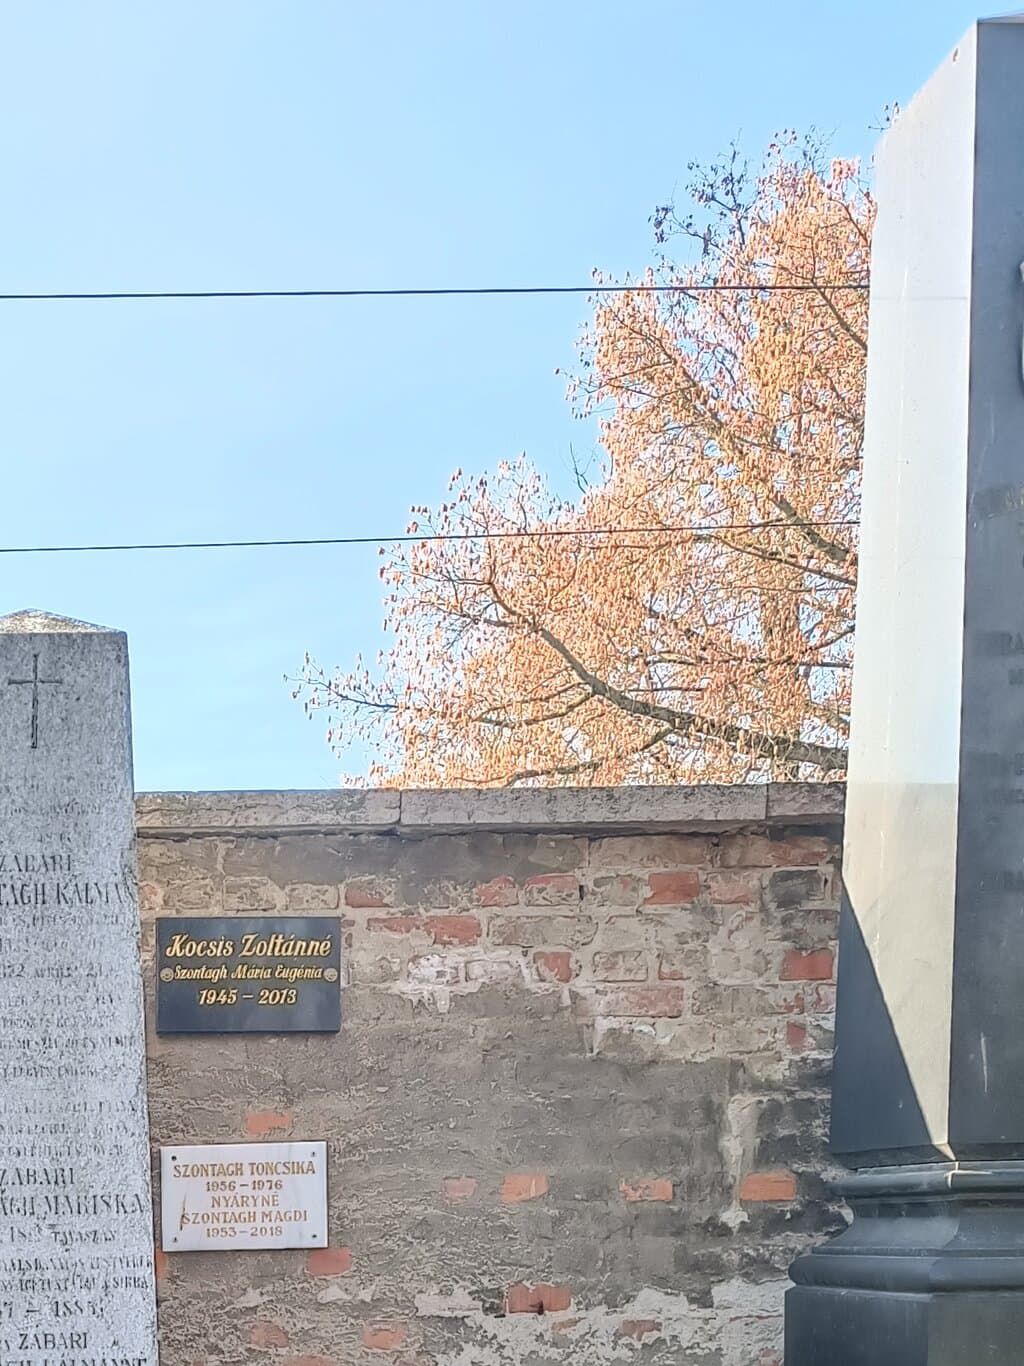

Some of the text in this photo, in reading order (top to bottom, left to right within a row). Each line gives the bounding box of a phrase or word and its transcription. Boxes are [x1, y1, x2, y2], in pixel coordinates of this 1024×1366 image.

[164, 932, 334, 958] Kocsis Zoltánné
[174, 964, 323, 983] Szontagh Mária Eugénia
[198, 988, 239, 1005] 1945
[258, 988, 297, 1005] 2013
[172, 1160, 317, 1179] SZONTAGH TONCSIKA
[210, 1191, 281, 1208] NYÁRYNÉ
[180, 1209, 309, 1226] SZONTAGH MAGDI
[18, 1331, 89, 1351] ZABARI
